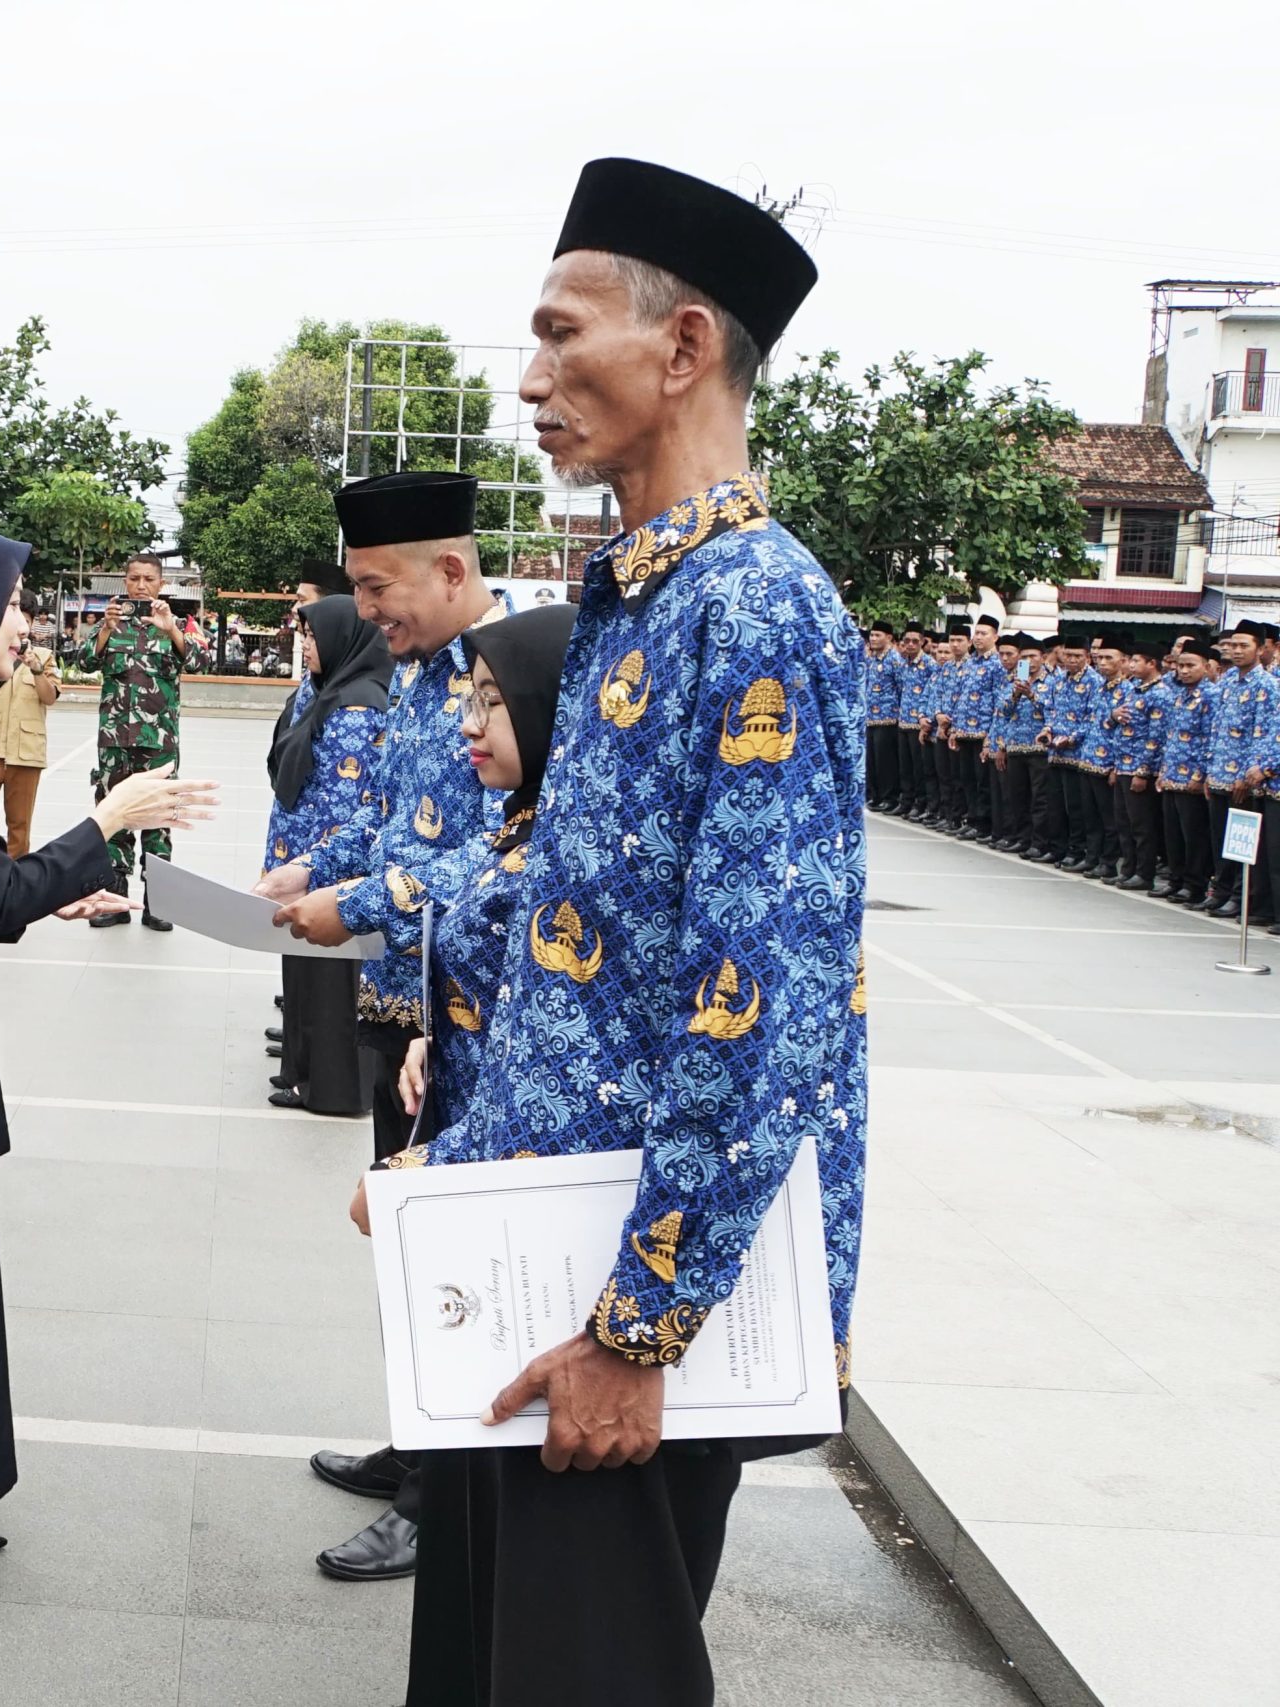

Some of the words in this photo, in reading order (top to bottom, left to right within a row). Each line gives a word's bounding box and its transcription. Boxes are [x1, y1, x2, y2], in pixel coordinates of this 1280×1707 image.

[1228, 839, 1254, 857] PRIA
[1230, 823, 1256, 844] PPPK
[484, 1257, 505, 1304] Serang
[520, 1255, 530, 1288] BUPATI
[565, 1254, 573, 1275] PPPK
[542, 1282, 552, 1318] TENTANG
[748, 1302, 757, 1325] DAYA
[489, 1307, 511, 1352] Bupati
[523, 1291, 535, 1348] KEPUTUSAN
[736, 1288, 749, 1356] KEPEGAWAIAN
[725, 1309, 739, 1377] PEMERINTAH
[751, 1328, 760, 1365] SUMBER
[742, 1358, 752, 1389] BADAN
